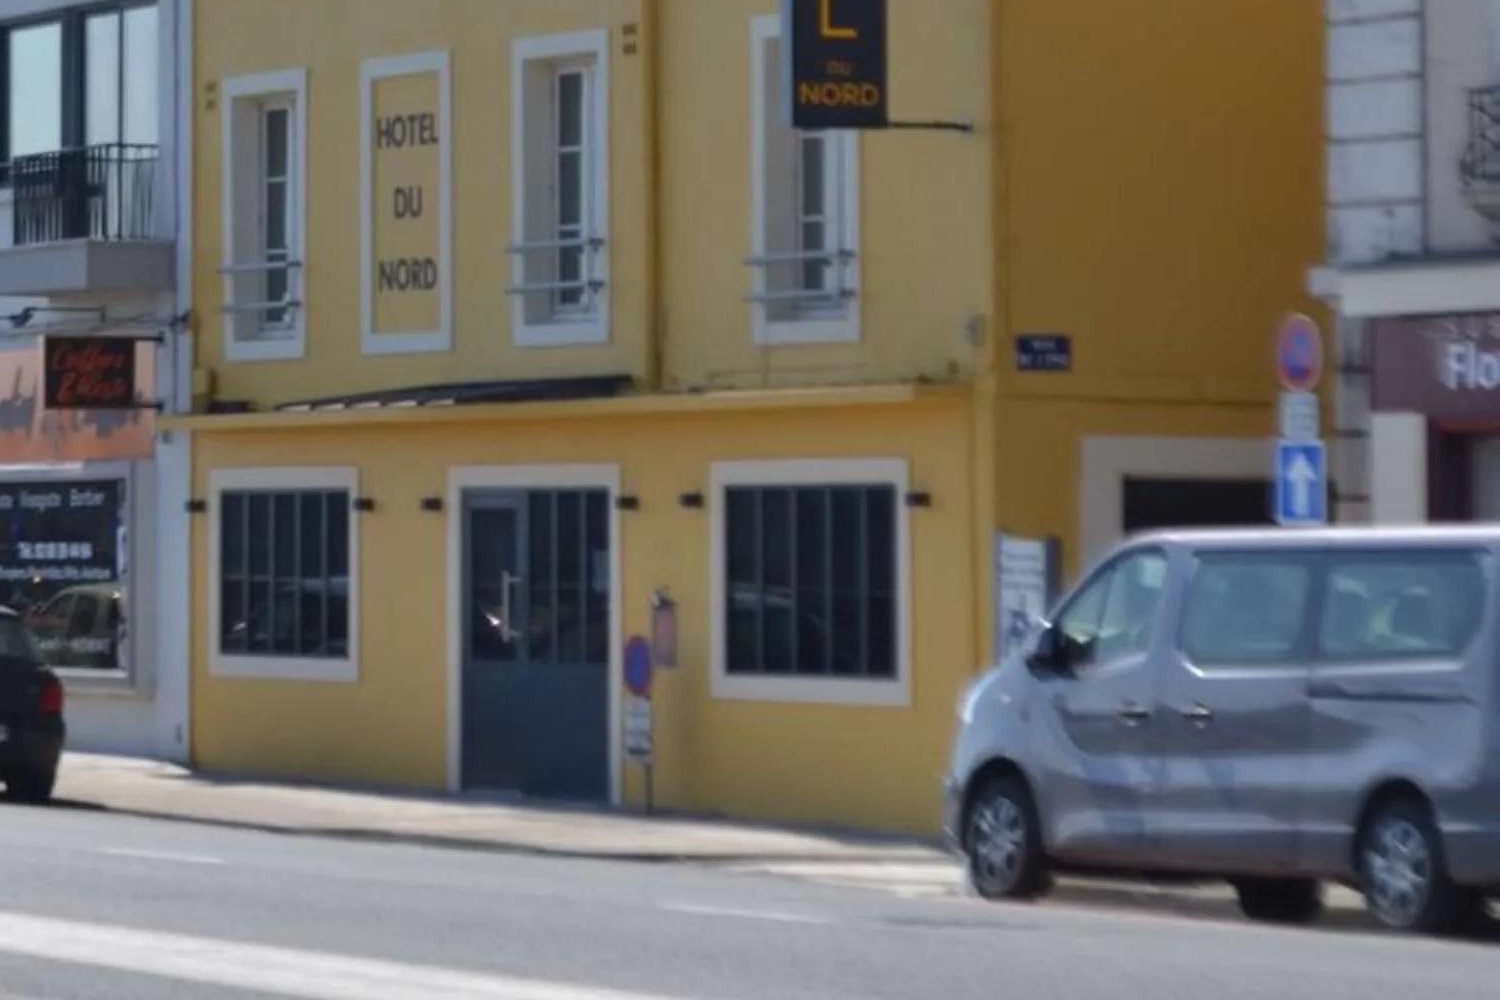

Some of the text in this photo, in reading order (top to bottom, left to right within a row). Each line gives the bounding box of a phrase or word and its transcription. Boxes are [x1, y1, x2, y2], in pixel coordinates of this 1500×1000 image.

[800, 81, 879, 106] NORD
[376, 113, 439, 148] HOTEL
[394, 186, 423, 219] DU
[378, 257, 438, 294] NORD
